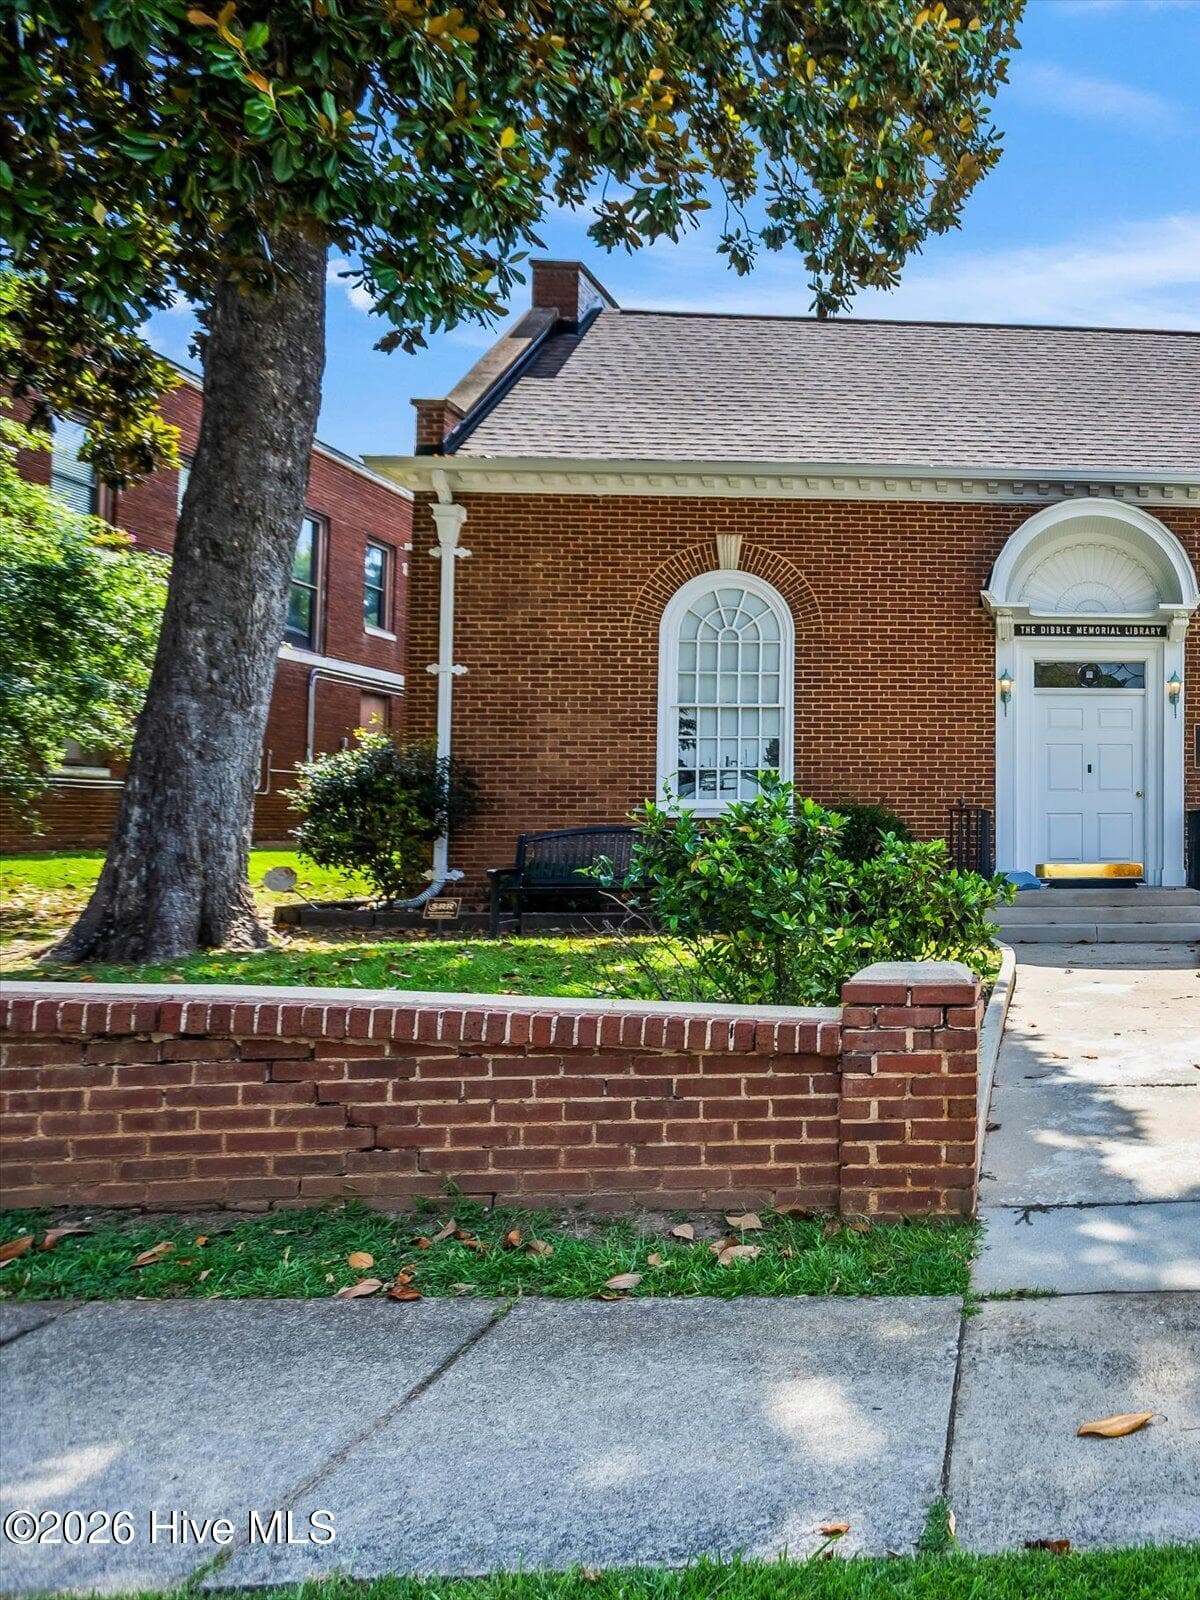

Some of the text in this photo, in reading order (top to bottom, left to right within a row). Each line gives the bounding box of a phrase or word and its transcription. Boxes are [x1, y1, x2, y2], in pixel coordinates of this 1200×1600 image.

[1020, 625, 1162, 635] THE DIBBLE MEMORIAL LIBRARY
